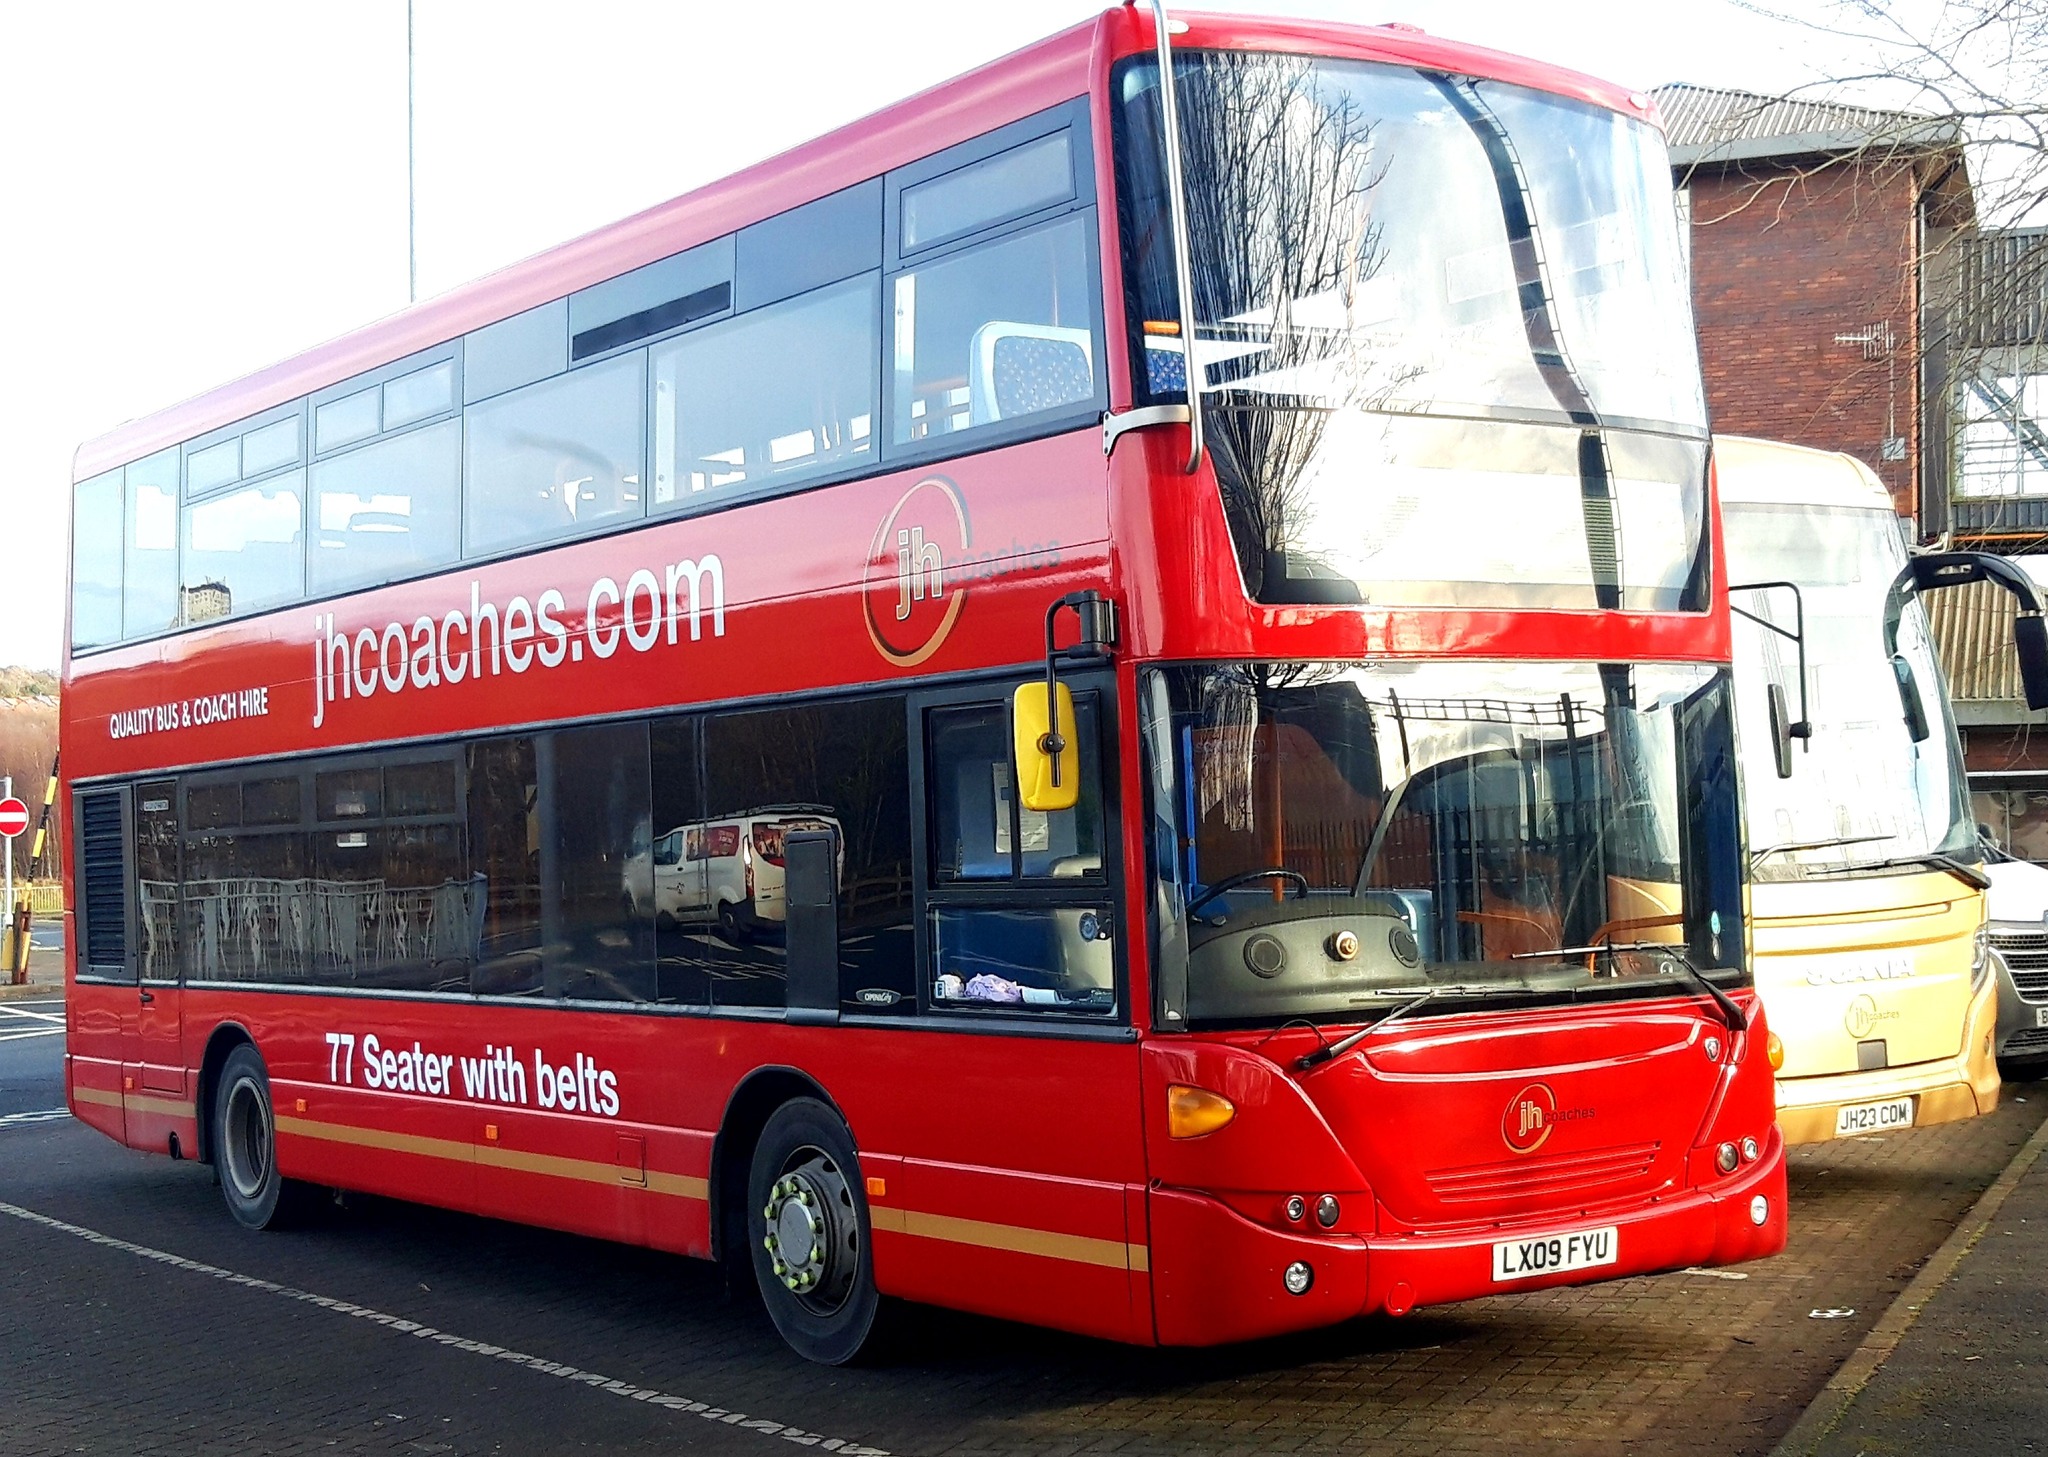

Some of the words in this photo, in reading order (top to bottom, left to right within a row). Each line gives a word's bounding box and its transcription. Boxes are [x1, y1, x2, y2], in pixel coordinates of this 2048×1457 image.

[896, 526, 944, 621] jh
[946, 537, 1061, 582] coaches
[313, 553, 726, 729] jhcoaches.com
[110, 708, 155, 739] QUALITY
[157, 703, 179, 730] BUS
[182, 701, 191, 727] &
[193, 692, 237, 725] COACH
[240, 687, 269, 718] HIRE
[325, 1032, 355, 1084] 77
[362, 1033, 453, 1095] Seater
[460, 1044, 528, 1104] with
[535, 1048, 620, 1117] belts
[1519, 1101, 1543, 1137] jh
[1543, 1107, 1596, 1126] coaches
[1840, 1108, 1877, 1131] JH23
[1880, 1103, 1908, 1123] COM
[1503, 1239, 1563, 1274] LX09
[1568, 1231, 1609, 1264] FYU
